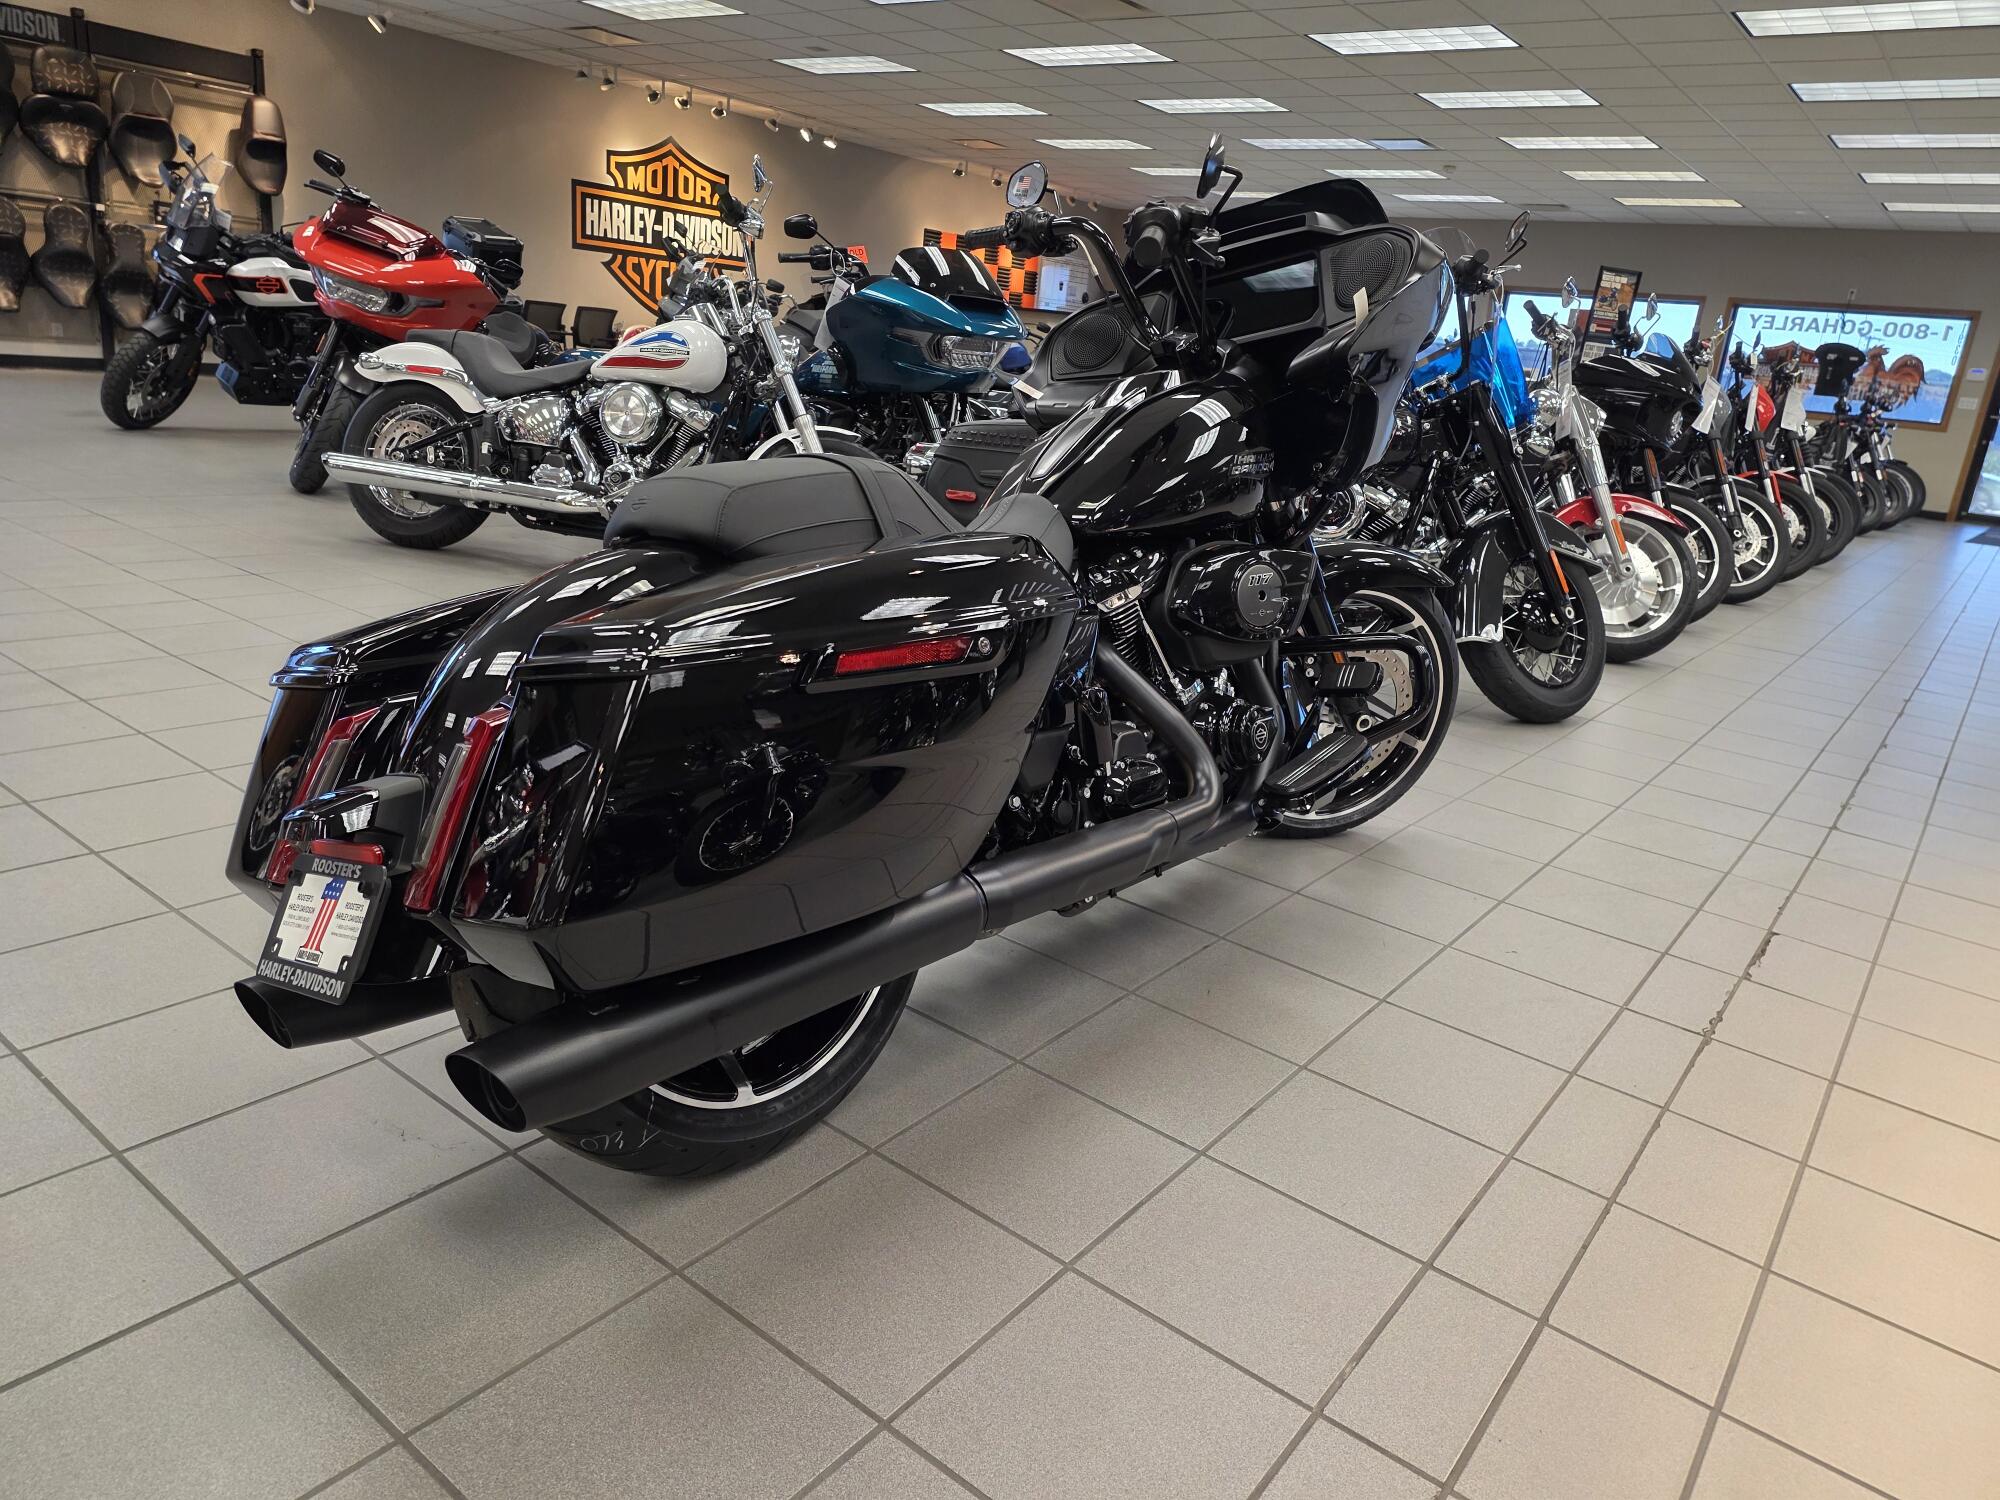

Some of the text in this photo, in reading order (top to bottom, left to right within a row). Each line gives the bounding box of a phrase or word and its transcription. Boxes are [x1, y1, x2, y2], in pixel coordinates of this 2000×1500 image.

[627, 156, 712, 206] MOTOR
[585, 197, 744, 258] HARLEY-DAVIDSON
[1248, 572, 1274, 587] 117
[311, 858, 362, 879] ROOSTER'S
[257, 959, 345, 998] HARLEY-DAVIDSON
